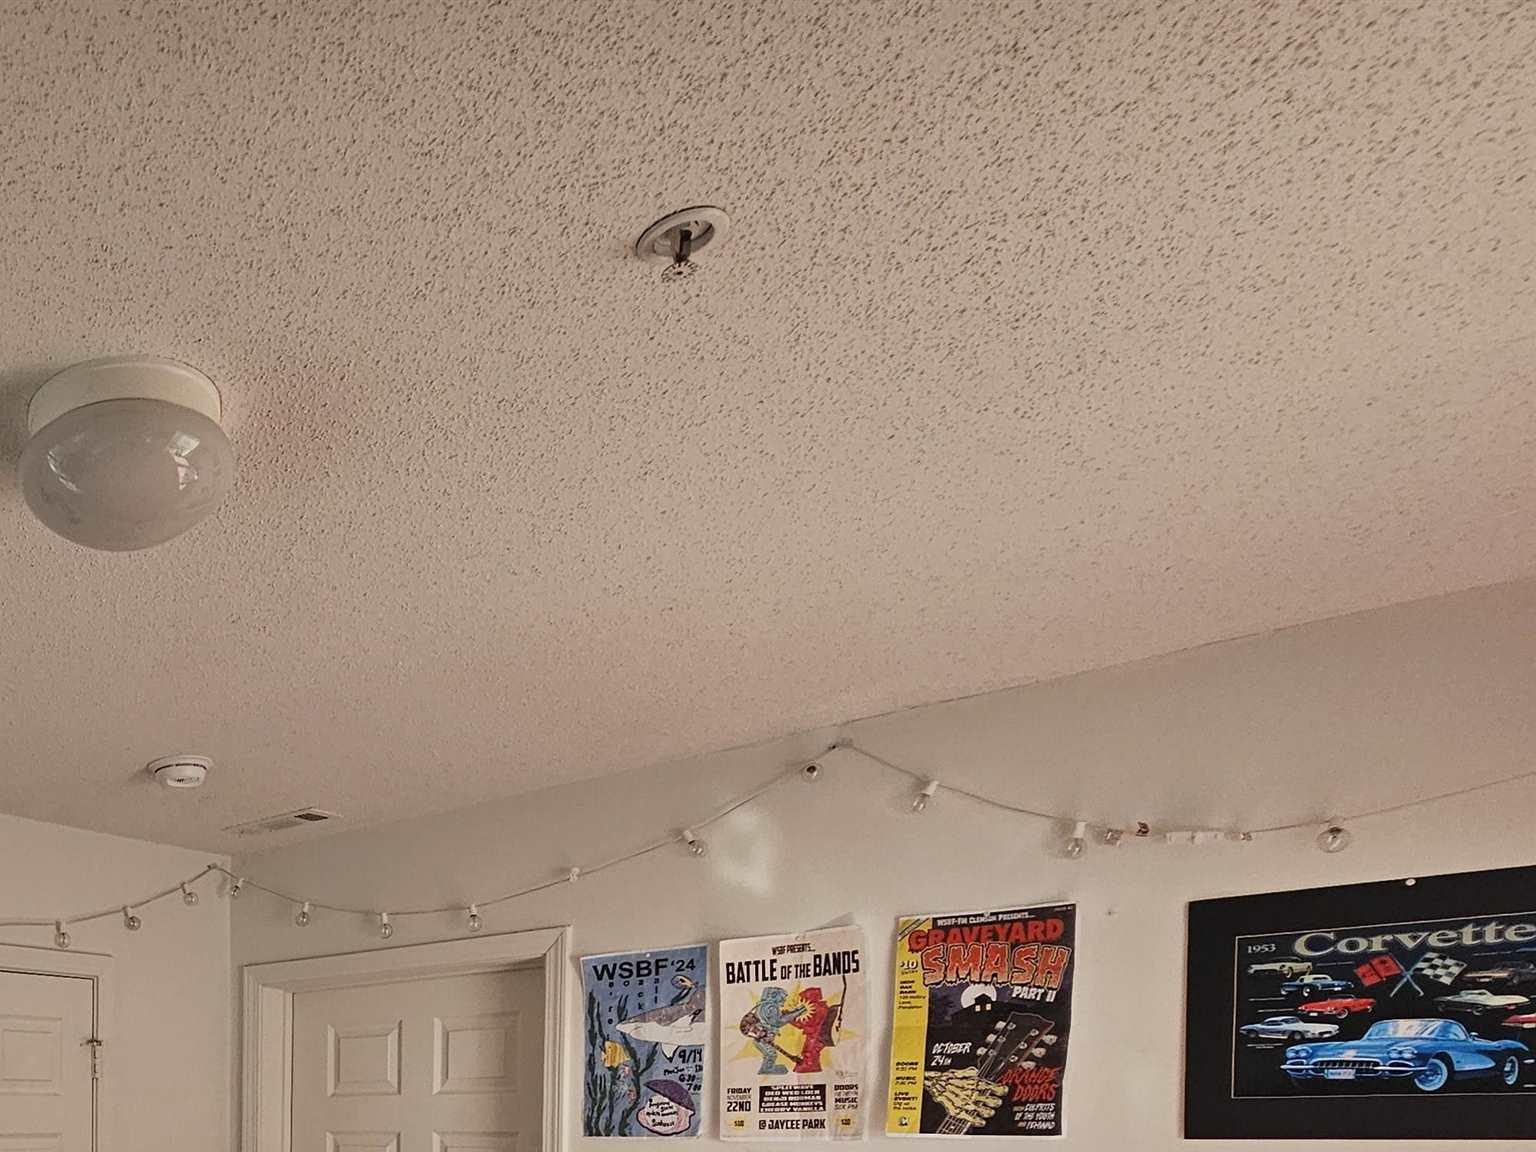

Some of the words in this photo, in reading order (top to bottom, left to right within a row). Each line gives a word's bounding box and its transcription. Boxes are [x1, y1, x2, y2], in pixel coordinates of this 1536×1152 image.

[908, 919, 1064, 952] GRAVEYARD
[1292, 921, 1536, 956] Corvette
[1247, 943, 1276, 954] 1953
[592, 958, 668, 981] WSBF
[726, 959, 778, 984] BATTLE
[780, 965, 793, 980] OF
[794, 963, 811, 979] THE
[813, 950, 860, 977] BANDS
[922, 942, 1071, 990] SMASH
[1013, 985, 1043, 1000] PART
[1046, 989, 1057, 1003] II
[678, 1048, 703, 1063] 9/14
[932, 1041, 973, 1054] OCTOBER
[1000, 1067, 1059, 1086] ORANGE
[727, 1087, 752, 1095] FRIDAY
[1012, 1083, 1057, 1102] DOORS
[726, 1100, 752, 1112] 22ND
[758, 1119, 767, 1130] @
[768, 1119, 801, 1130] JAYCEE
[801, 1119, 826, 1130] PARK
